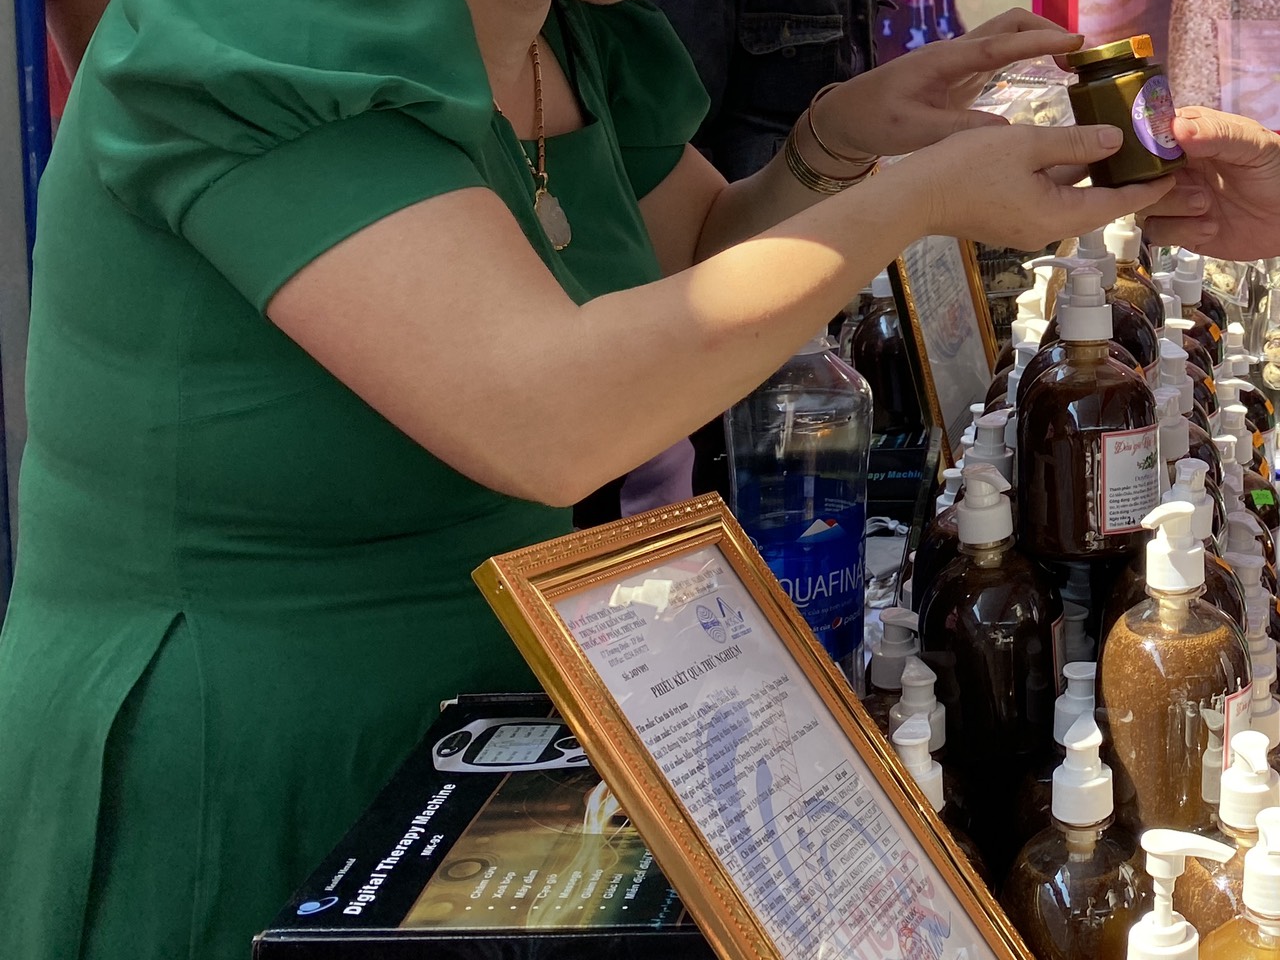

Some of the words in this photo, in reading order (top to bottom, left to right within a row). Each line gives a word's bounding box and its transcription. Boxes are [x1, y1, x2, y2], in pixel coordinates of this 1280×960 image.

[779, 556, 865, 608] QUAFINA
[648, 675, 675, 698] PHIẾU
[669, 668, 690, 686] KẾT
[683, 660, 705, 681] QUẢ
[713, 643, 743, 666] NGHIỆM
[343, 873, 388, 915] Digital
[375, 826, 426, 871] Therapy
[411, 783, 456, 825] Machine
[420, 834, 444, 856] MK-92
